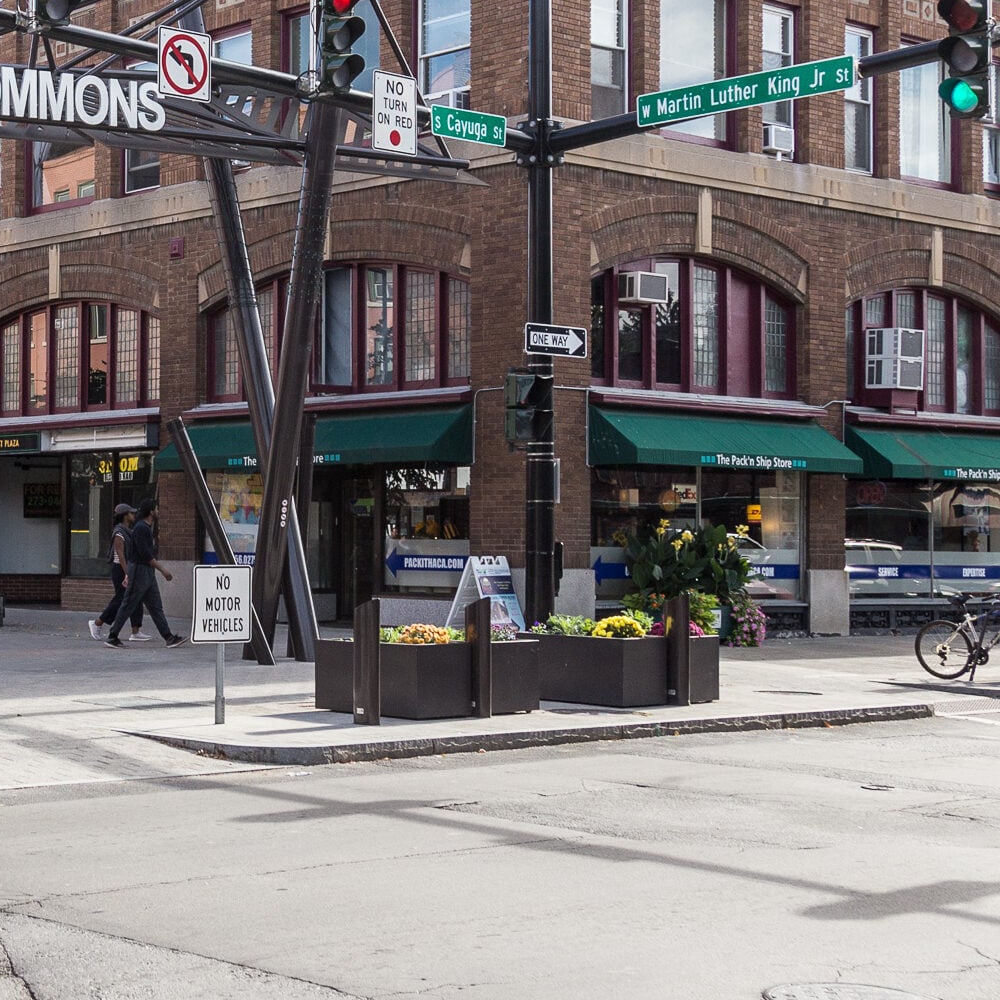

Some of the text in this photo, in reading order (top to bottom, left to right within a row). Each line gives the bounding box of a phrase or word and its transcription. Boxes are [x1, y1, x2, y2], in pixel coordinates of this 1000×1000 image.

[386, 79, 405, 96] NO
[642, 67, 850, 119] W Martin Luther King Jr St
[383, 97, 408, 113] TURN
[377, 112, 413, 129] ON RED
[434, 114, 503, 141] S Cayuga St
[532, 333, 569, 347] ONE WAY
[4, 439, 20, 448] PLAZA
[243, 456, 257, 466] The
[716, 453, 793, 470] The Pack'n Ship Store
[956, 468, 968, 479] The
[404, 557, 464, 569] PACKITHACA.COM
[878, 567, 899, 577] SERVICE
[962, 567, 986, 578] EXPERTISE
[216, 575, 230, 590] NO
[205, 596, 241, 611] MOTOR
[202, 617, 244, 632] VEHICLES
